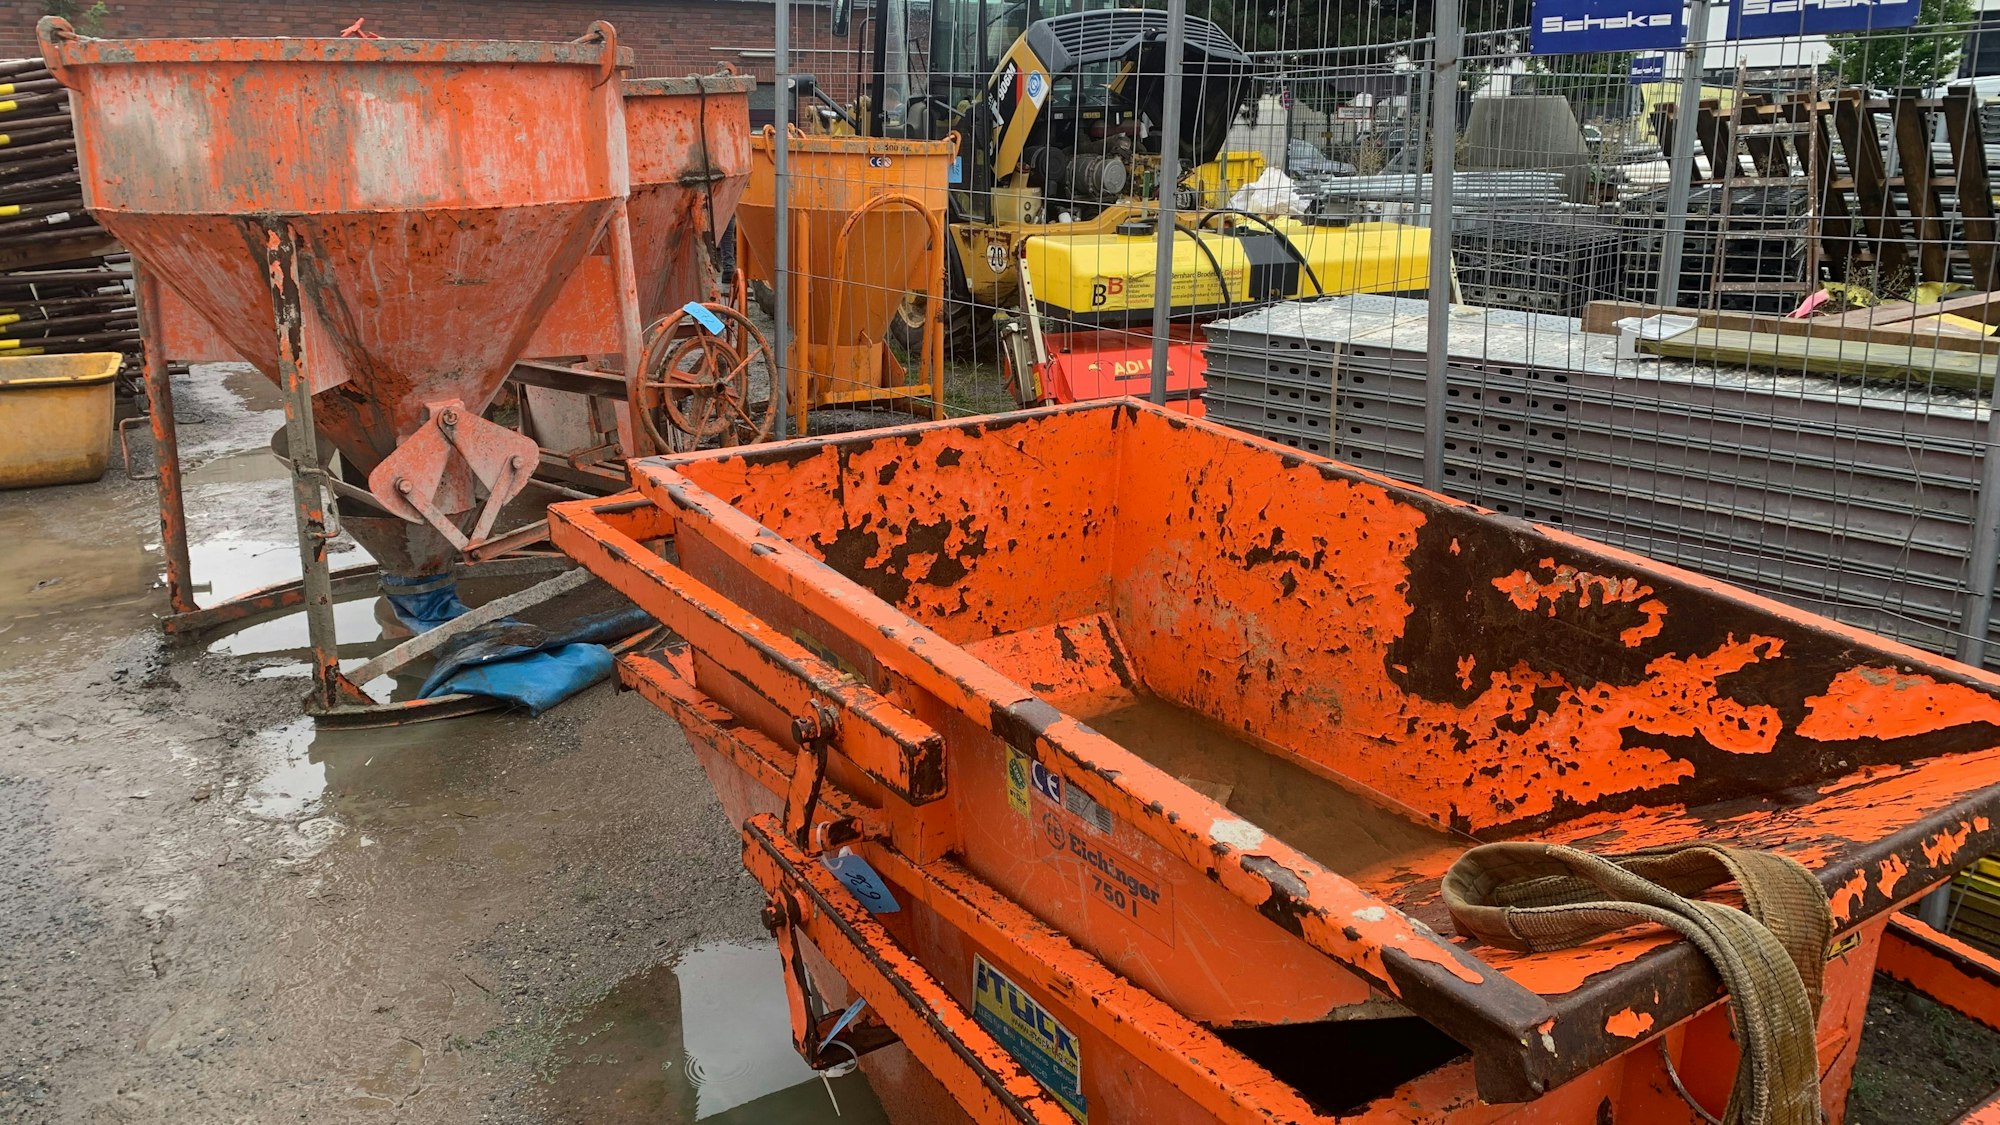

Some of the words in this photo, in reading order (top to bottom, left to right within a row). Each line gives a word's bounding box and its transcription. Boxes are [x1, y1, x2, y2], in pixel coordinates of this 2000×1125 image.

[1542, 11, 1672, 33] Schake
[998, 62, 1016, 101] 906M
[990, 246, 1004, 267] 20
[1032, 760, 1059, 803] CE
[1069, 831, 1160, 906] Eichinger
[1092, 874, 1126, 910] 750
[1012, 1046, 1048, 1079] Service
